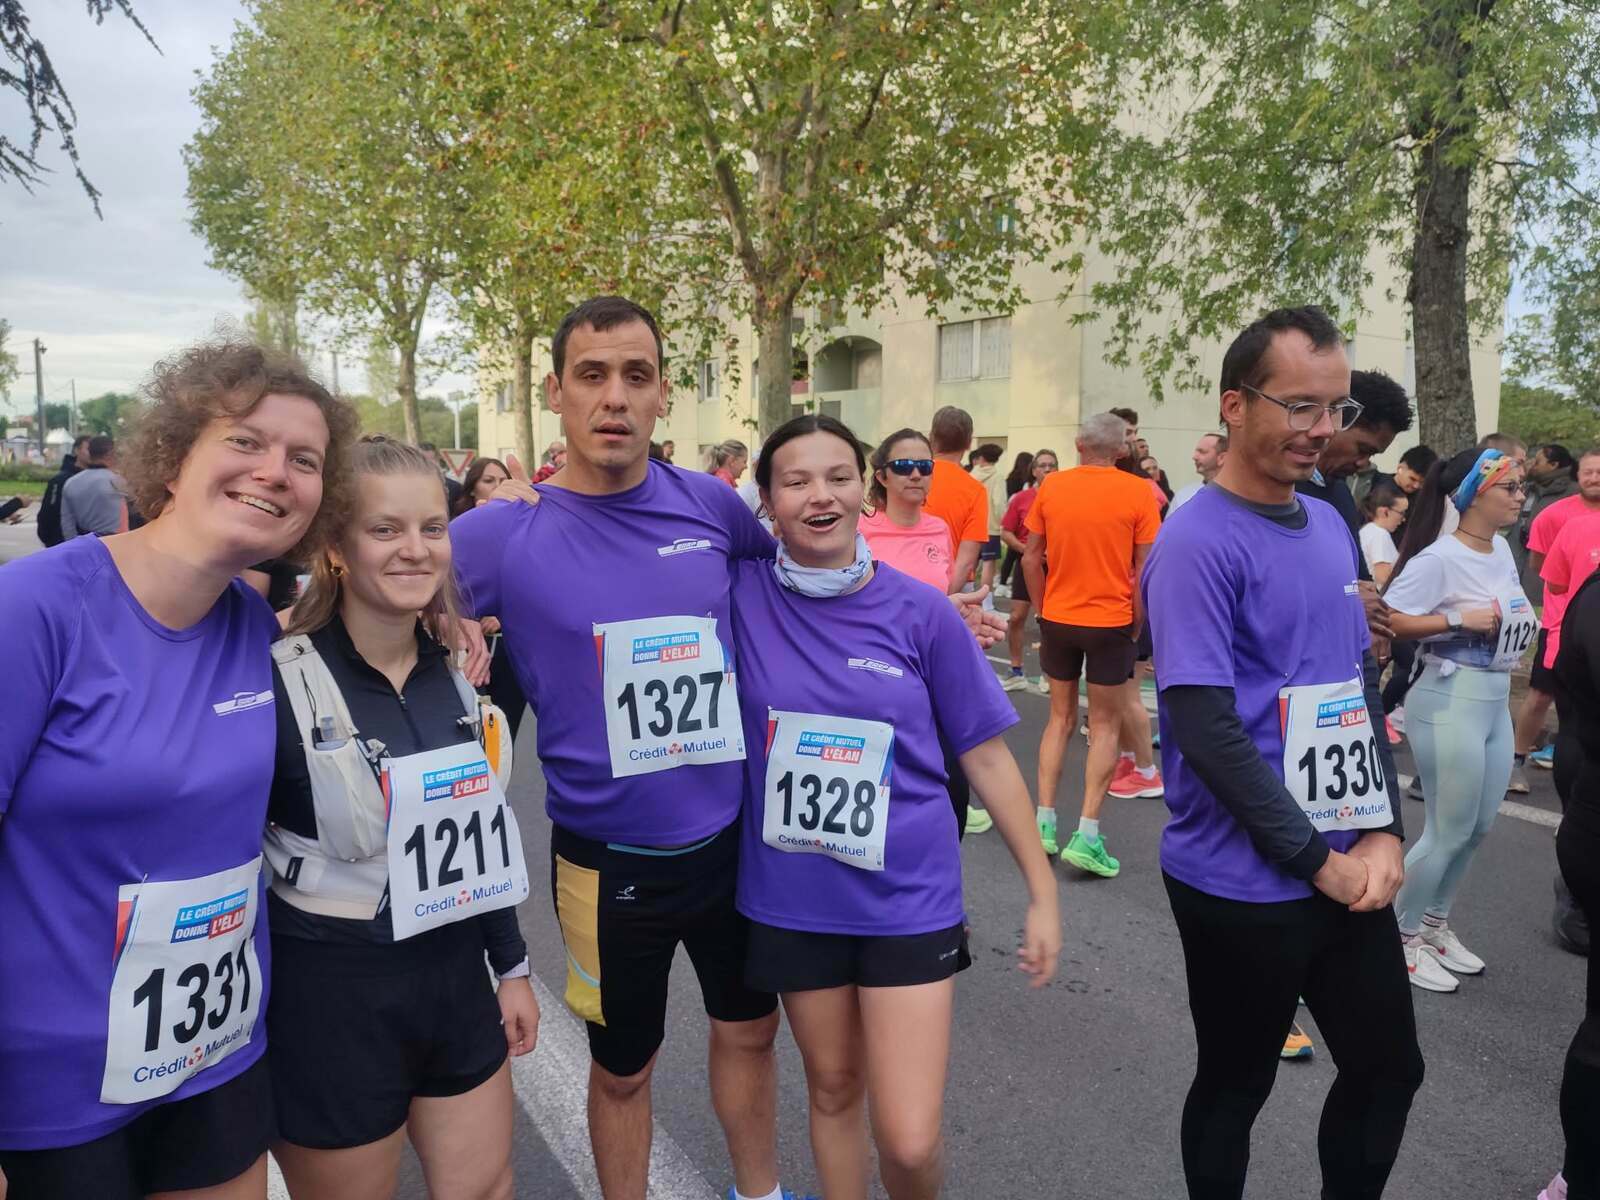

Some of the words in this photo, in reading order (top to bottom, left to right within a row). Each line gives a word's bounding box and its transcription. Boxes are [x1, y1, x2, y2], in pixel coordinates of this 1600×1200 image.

[635, 640, 644, 649] LE
[645, 636, 670, 647] CRÉDIT
[671, 634, 697, 644] MUTUEL
[635, 651, 659, 661] DONNE
[662, 644, 698, 660] L'ÉLAN
[617, 671, 723, 740] 1327
[1320, 705, 1328, 713] LE
[1318, 715, 1340, 726] DONNE
[1341, 709, 1366, 726] L'ÉLAN
[629, 746, 668, 761] Crédit
[683, 737, 726, 753] Mutuel
[801, 733, 811, 741] LE
[811, 733, 835, 744] CRÉDIT
[835, 737, 862, 747] MUTUEL
[798, 745, 822, 755] DONNE
[823, 746, 860, 762] L'ÉLAN
[425, 775, 435, 784] LE
[435, 768, 463, 782] CRÉDIT
[463, 763, 487, 776] MUTUEL
[1299, 736, 1383, 801] 1330
[426, 785, 452, 799] DONNE
[455, 774, 488, 796] L'ÉLAN
[777, 771, 876, 837] 1328
[404, 803, 510, 892] 1211
[778, 834, 813, 847] Crédit
[826, 842, 866, 857] Mutuel
[414, 896, 456, 917] Crédit
[472, 878, 512, 901] Mutuel
[180, 910, 194, 922] LE
[194, 901, 223, 918] CRÉDIT
[175, 922, 209, 939] DONNE
[133, 938, 250, 1052] 1331
[133, 1055, 188, 1083] Crédit
[204, 1023, 243, 1057] Mutuel
